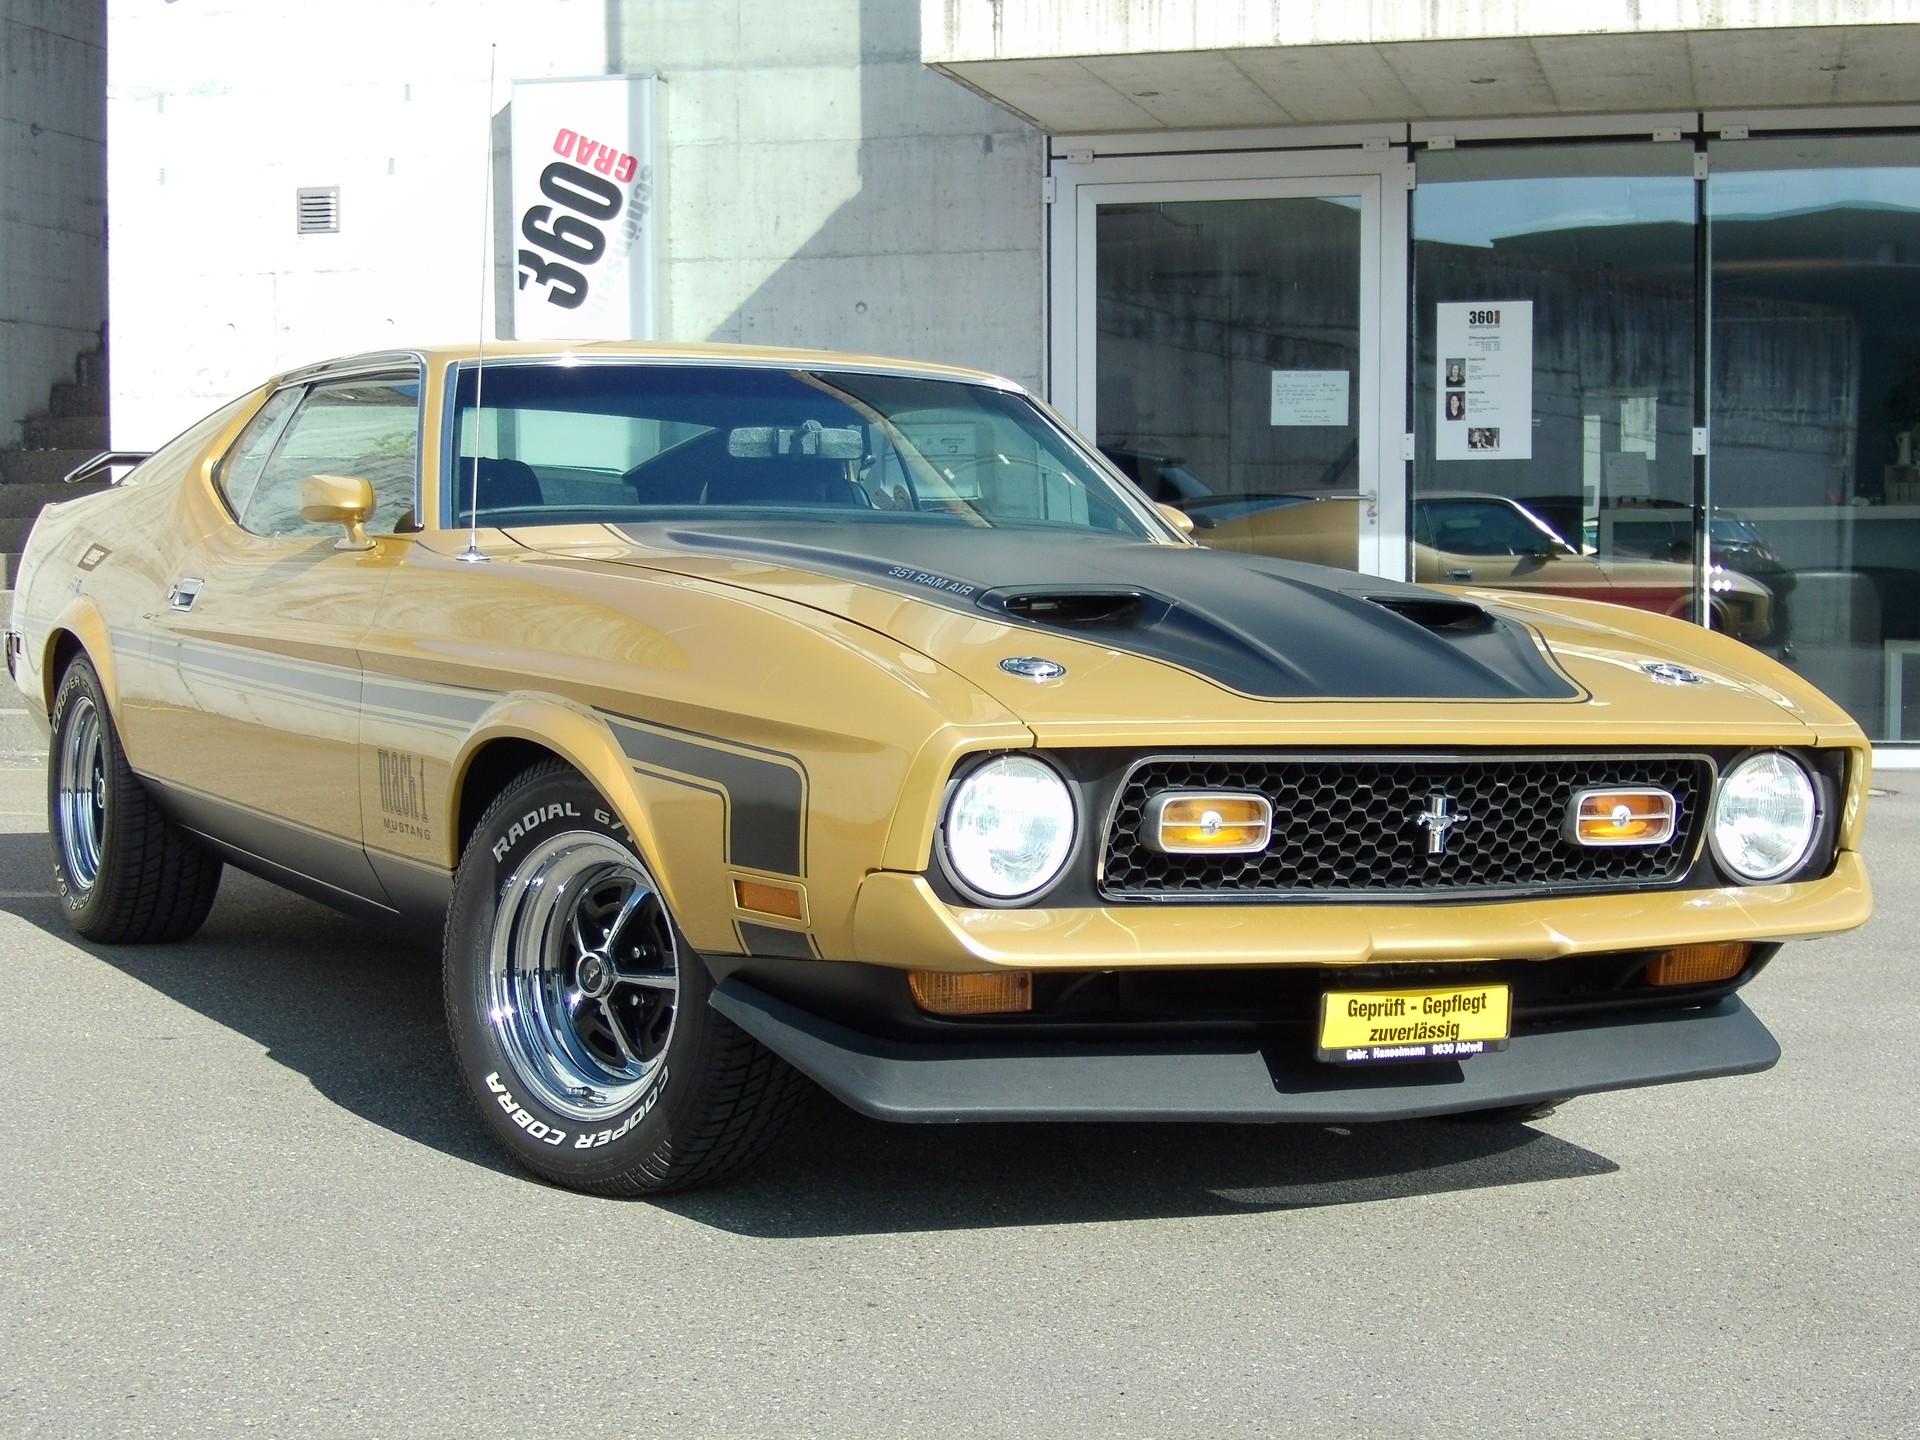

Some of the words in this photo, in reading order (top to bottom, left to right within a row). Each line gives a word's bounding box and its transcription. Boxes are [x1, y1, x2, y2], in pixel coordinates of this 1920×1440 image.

[553, 128, 638, 183] GRAD
[518, 162, 624, 309] 360
[1469, 310, 1494, 325] 360
[888, 566, 916, 579] 351
[914, 573, 948, 588] RAM
[946, 582, 975, 595] AIR
[53, 676, 80, 734] COOPER
[383, 818, 431, 841] MUSTANG
[492, 802, 581, 863] RADIAL
[1347, 998, 1406, 1021] Geprüft
[1422, 992, 1487, 1017] Gepflegt
[1369, 1021, 1460, 1041] zuverlässig
[485, 1071, 567, 1146] COBRA
[575, 1066, 669, 1149] COOPER
